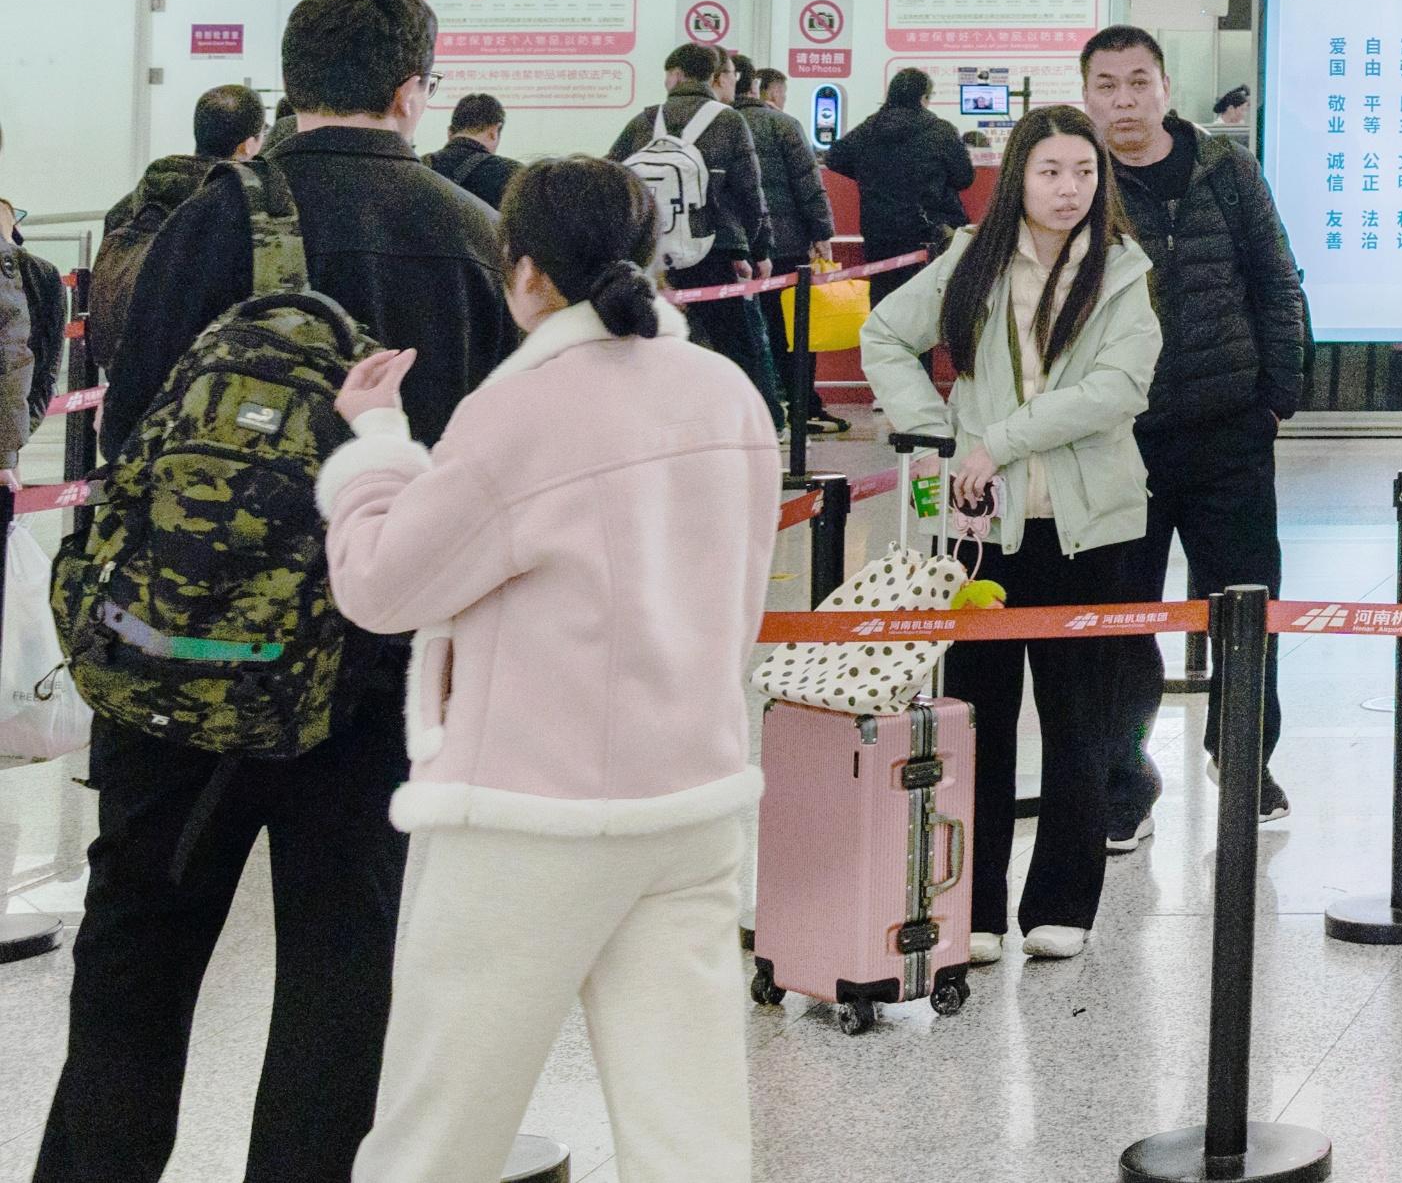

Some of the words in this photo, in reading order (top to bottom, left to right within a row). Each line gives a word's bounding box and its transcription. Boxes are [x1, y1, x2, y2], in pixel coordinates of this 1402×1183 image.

[796, 52, 845, 65] 请勿拍照
[1328, 37, 1347, 77] 爱国
[1364, 37, 1382, 77] 自由
[1327, 94, 1346, 135] 敬业
[1363, 95, 1381, 134] 平等
[1326, 152, 1345, 193] 诚信
[1362, 152, 1379, 193] 公正
[1325, 209, 1343, 251] 友善
[1360, 210, 1379, 251] 法治
